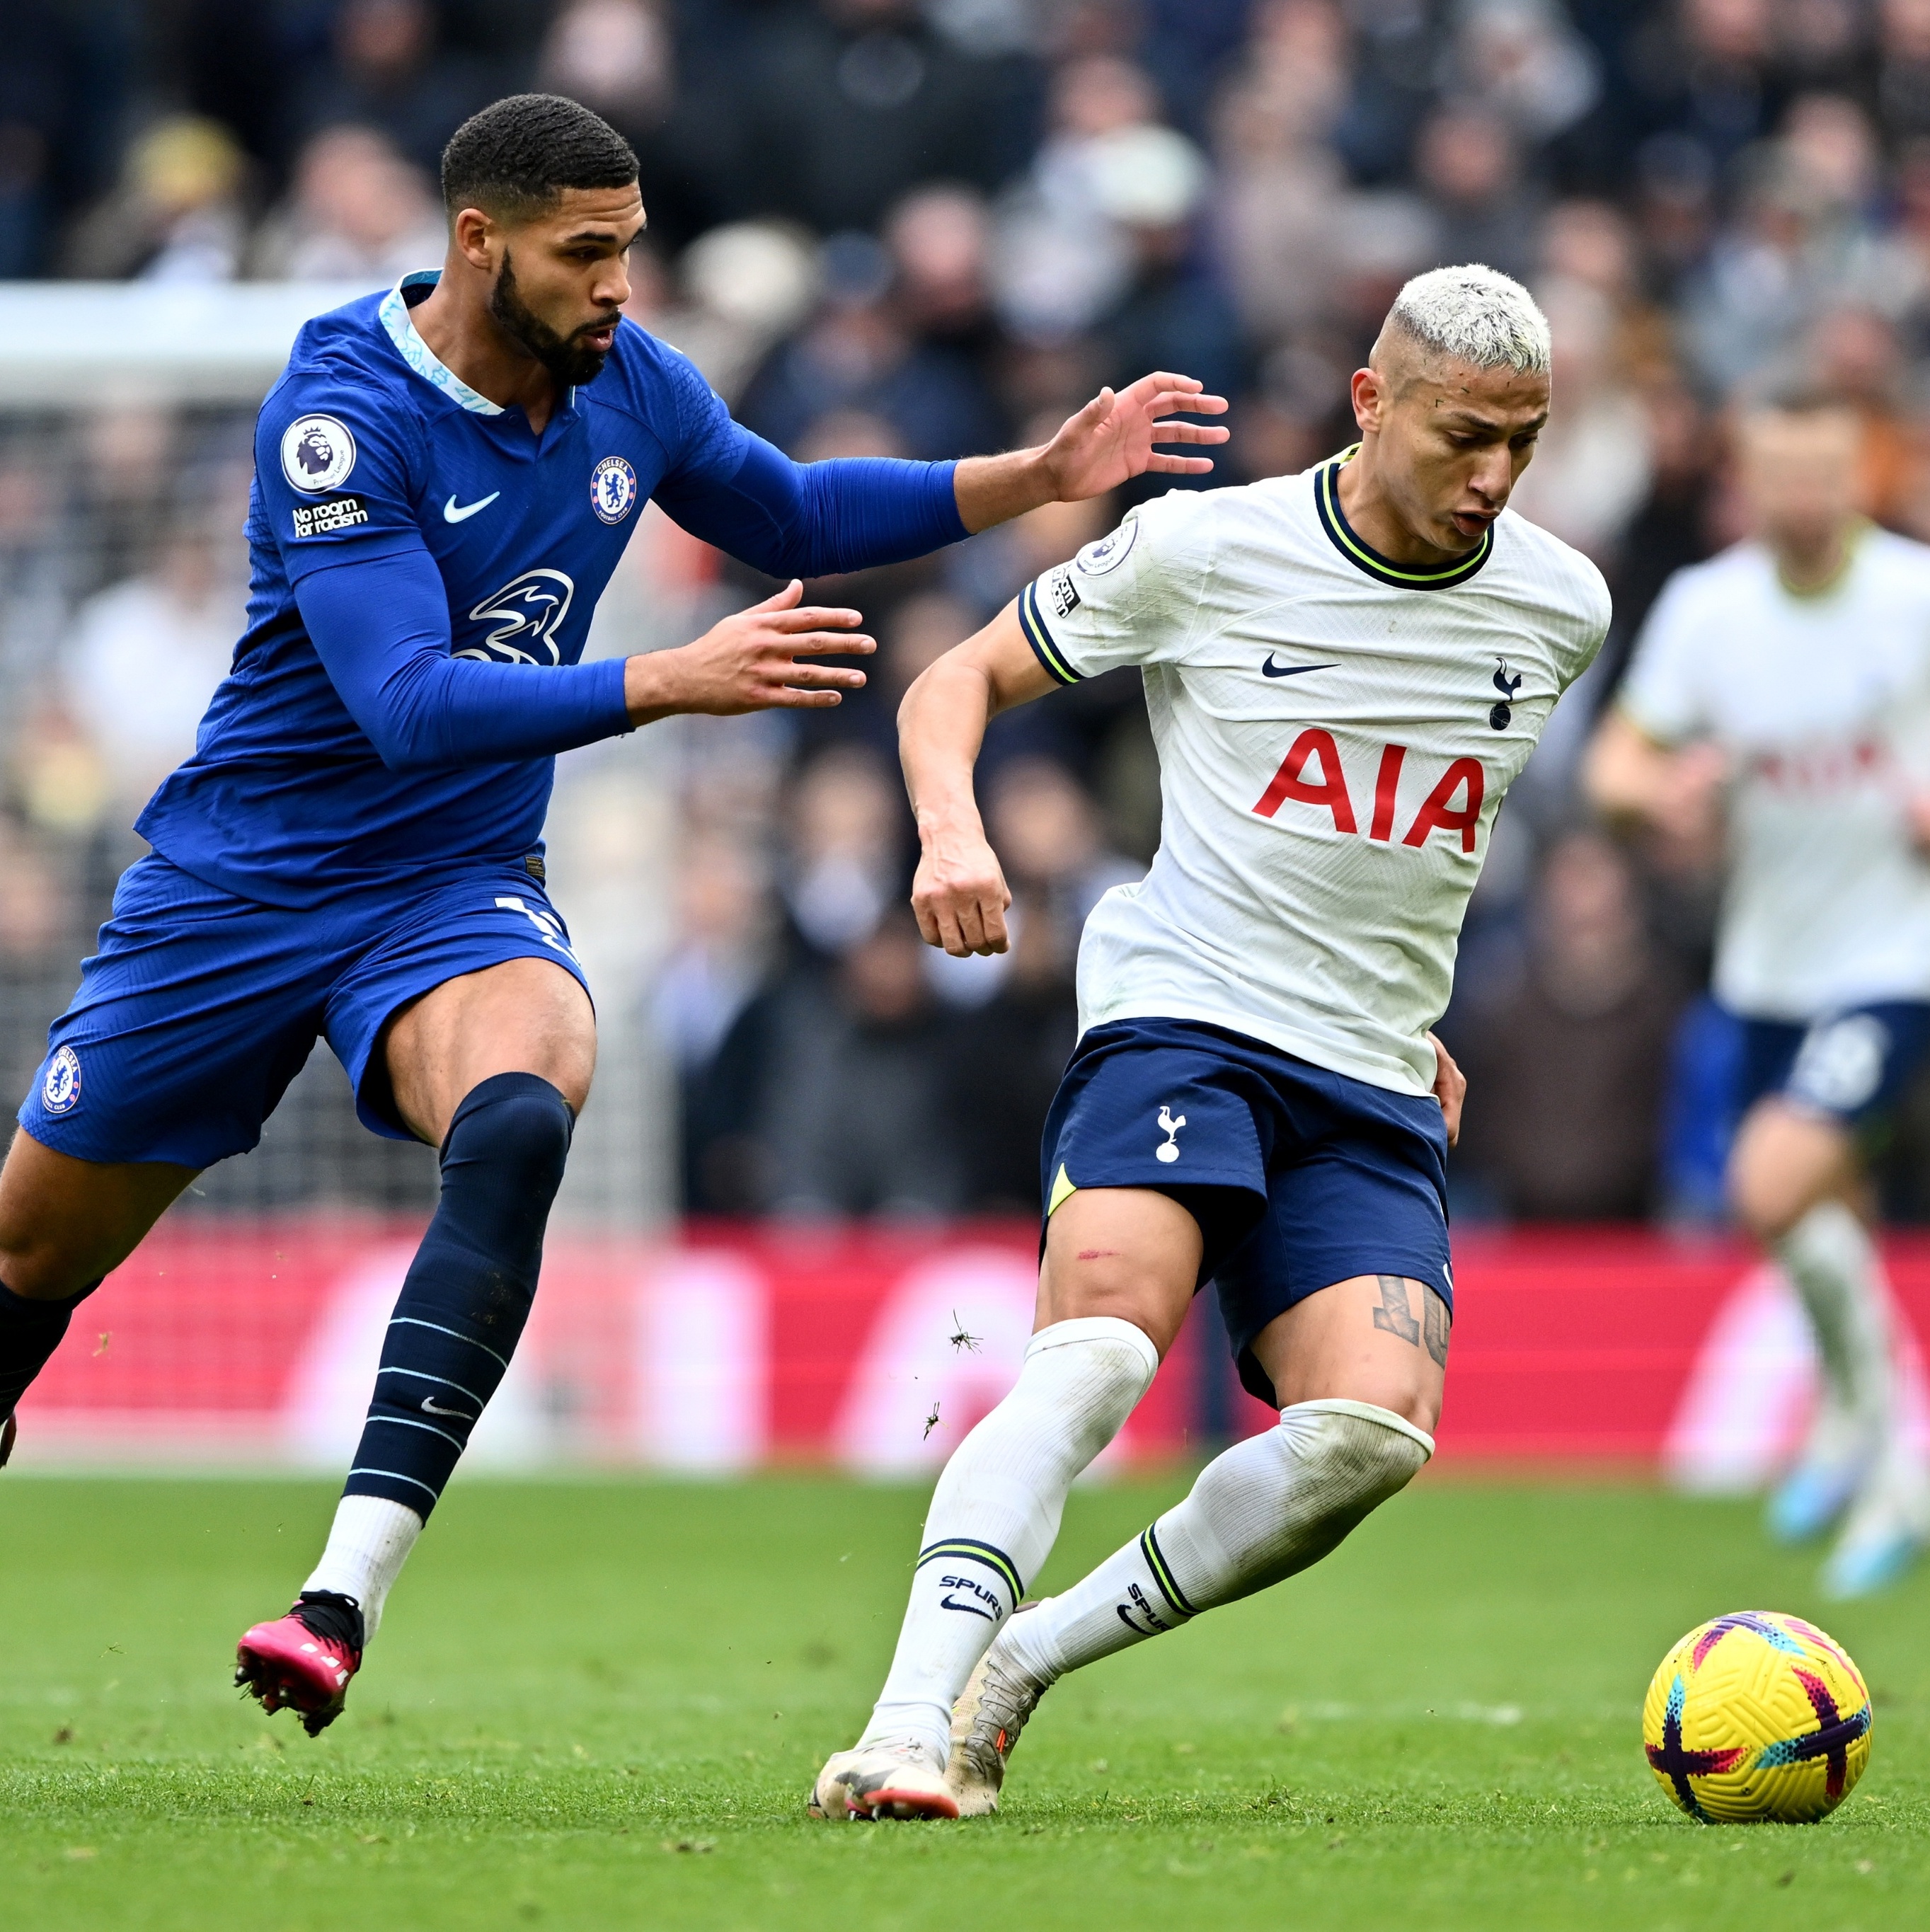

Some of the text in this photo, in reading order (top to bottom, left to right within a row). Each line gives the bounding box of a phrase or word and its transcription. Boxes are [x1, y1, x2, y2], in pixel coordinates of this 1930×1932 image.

[335, 449, 345, 473] League
[597, 459, 628, 475] CHELSEA
[292, 498, 358, 524] No room
[294, 509, 369, 539] for racism
[1251, 728, 1485, 853] AIA
[58, 1048, 78, 1074] CHELSEA
[938, 1575, 1004, 1621] SPURS
[1127, 1582, 1172, 1632] SPUR
